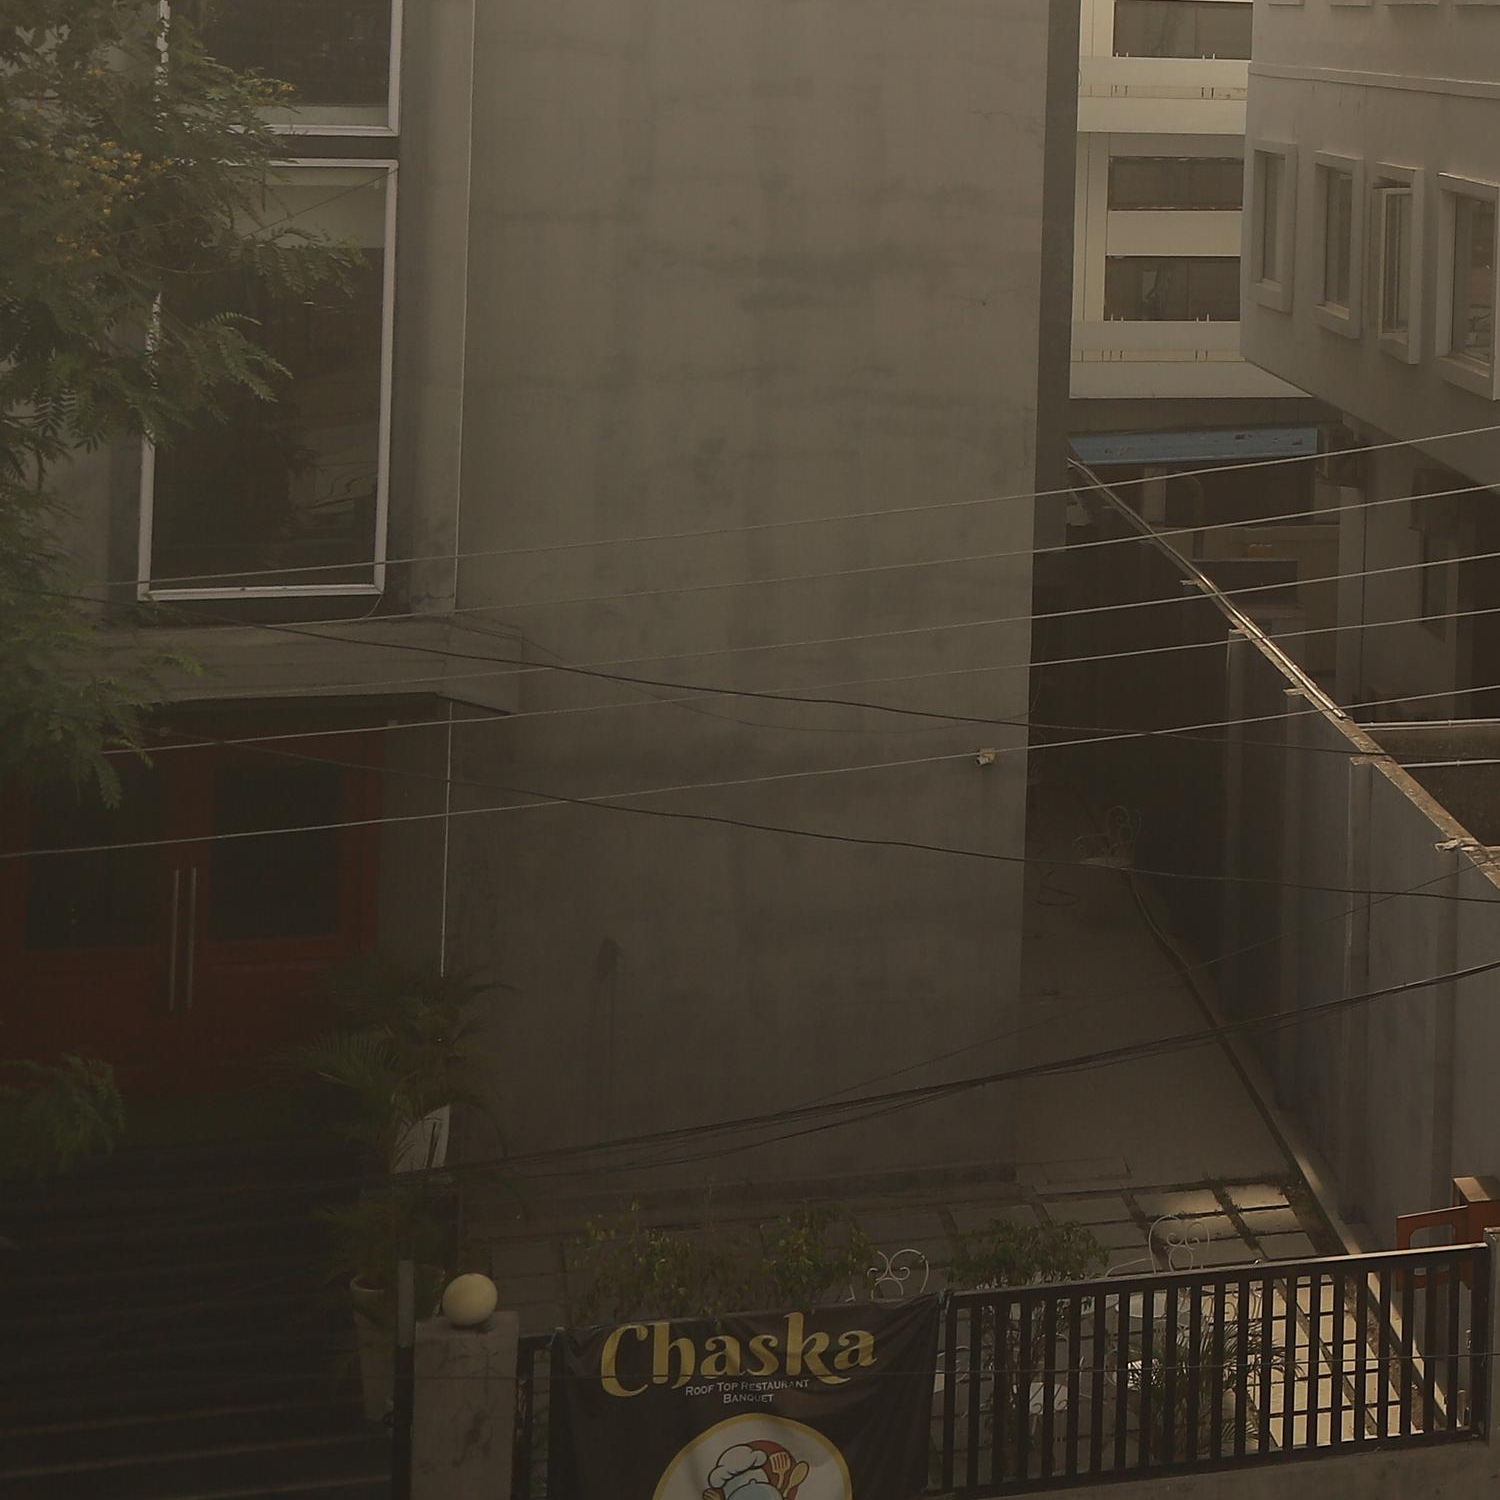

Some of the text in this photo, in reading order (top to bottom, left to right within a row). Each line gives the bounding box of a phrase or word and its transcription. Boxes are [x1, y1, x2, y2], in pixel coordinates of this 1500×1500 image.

[600, 1311, 878, 1398] Chaska
[685, 1379, 810, 1397] ROOF TOP RESTAURANT
[723, 1393, 775, 1405] BANQUET
